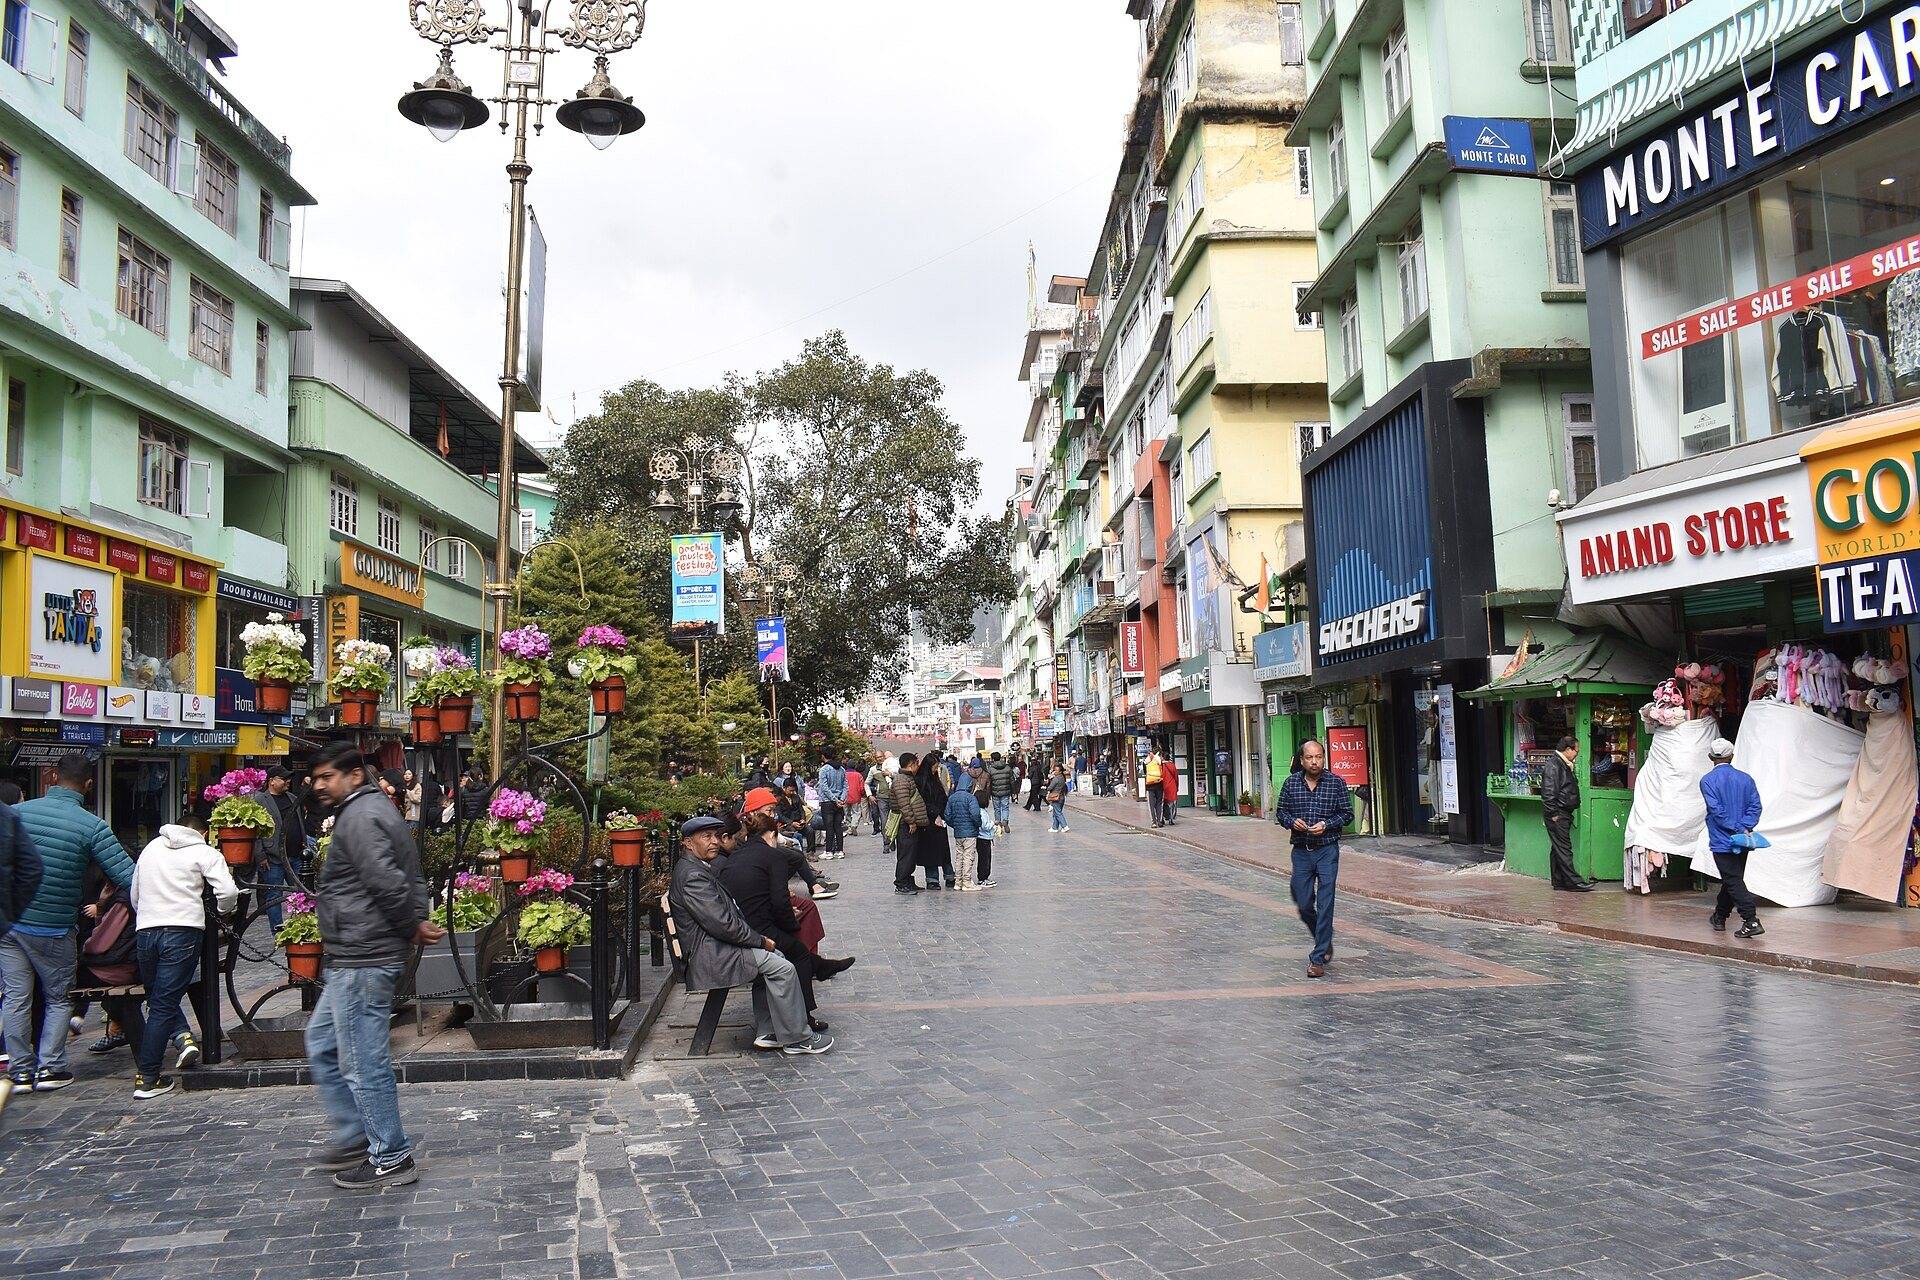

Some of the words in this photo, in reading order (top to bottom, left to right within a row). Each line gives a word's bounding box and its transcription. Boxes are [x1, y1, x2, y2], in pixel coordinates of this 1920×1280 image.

[1461, 149, 1494, 163] MONTE
[1497, 152, 1527, 166] CARLO
[1603, 82, 1779, 227] MONTE
[1651, 323, 1688, 353] SALE
[1699, 305, 1738, 337] SALE
[1751, 286, 1793, 319] SALE
[1807, 265, 1853, 300] SALE
[1871, 240, 1920, 277] SALE
[1816, 450, 1920, 532] GO
[29, 526, 47, 539] FEEDING
[76, 533, 92, 545] HEALTH
[1580, 522, 1675, 579] ANAND
[1685, 496, 1794, 557] STORE
[77, 545, 95, 558] HYGIENE
[112, 548, 121, 558] KIDS
[121, 550, 137, 563] FASHION
[157, 566, 168, 576] TOYS
[353, 549, 398, 588] GOLDEN
[676, 561, 716, 571] festival
[223, 583, 251, 598] ROOMS
[253, 591, 293, 609] AVAILABLE
[1820, 558, 1917, 624] TEA
[332, 601, 346, 633] TIPS
[1319, 592, 1421, 656] SKECHERS
[43, 609, 103, 653] PANDAS
[17, 688, 50, 700] TOFFYHOUSE
[65, 684, 95, 710] Barbie
[185, 711, 206, 719] peppermint
[67, 732, 91, 741] TRAVELS
[199, 732, 236, 744] CONVERSE
[1331, 740, 1363, 752] SALE
[1333, 761, 1351, 770] 40%
